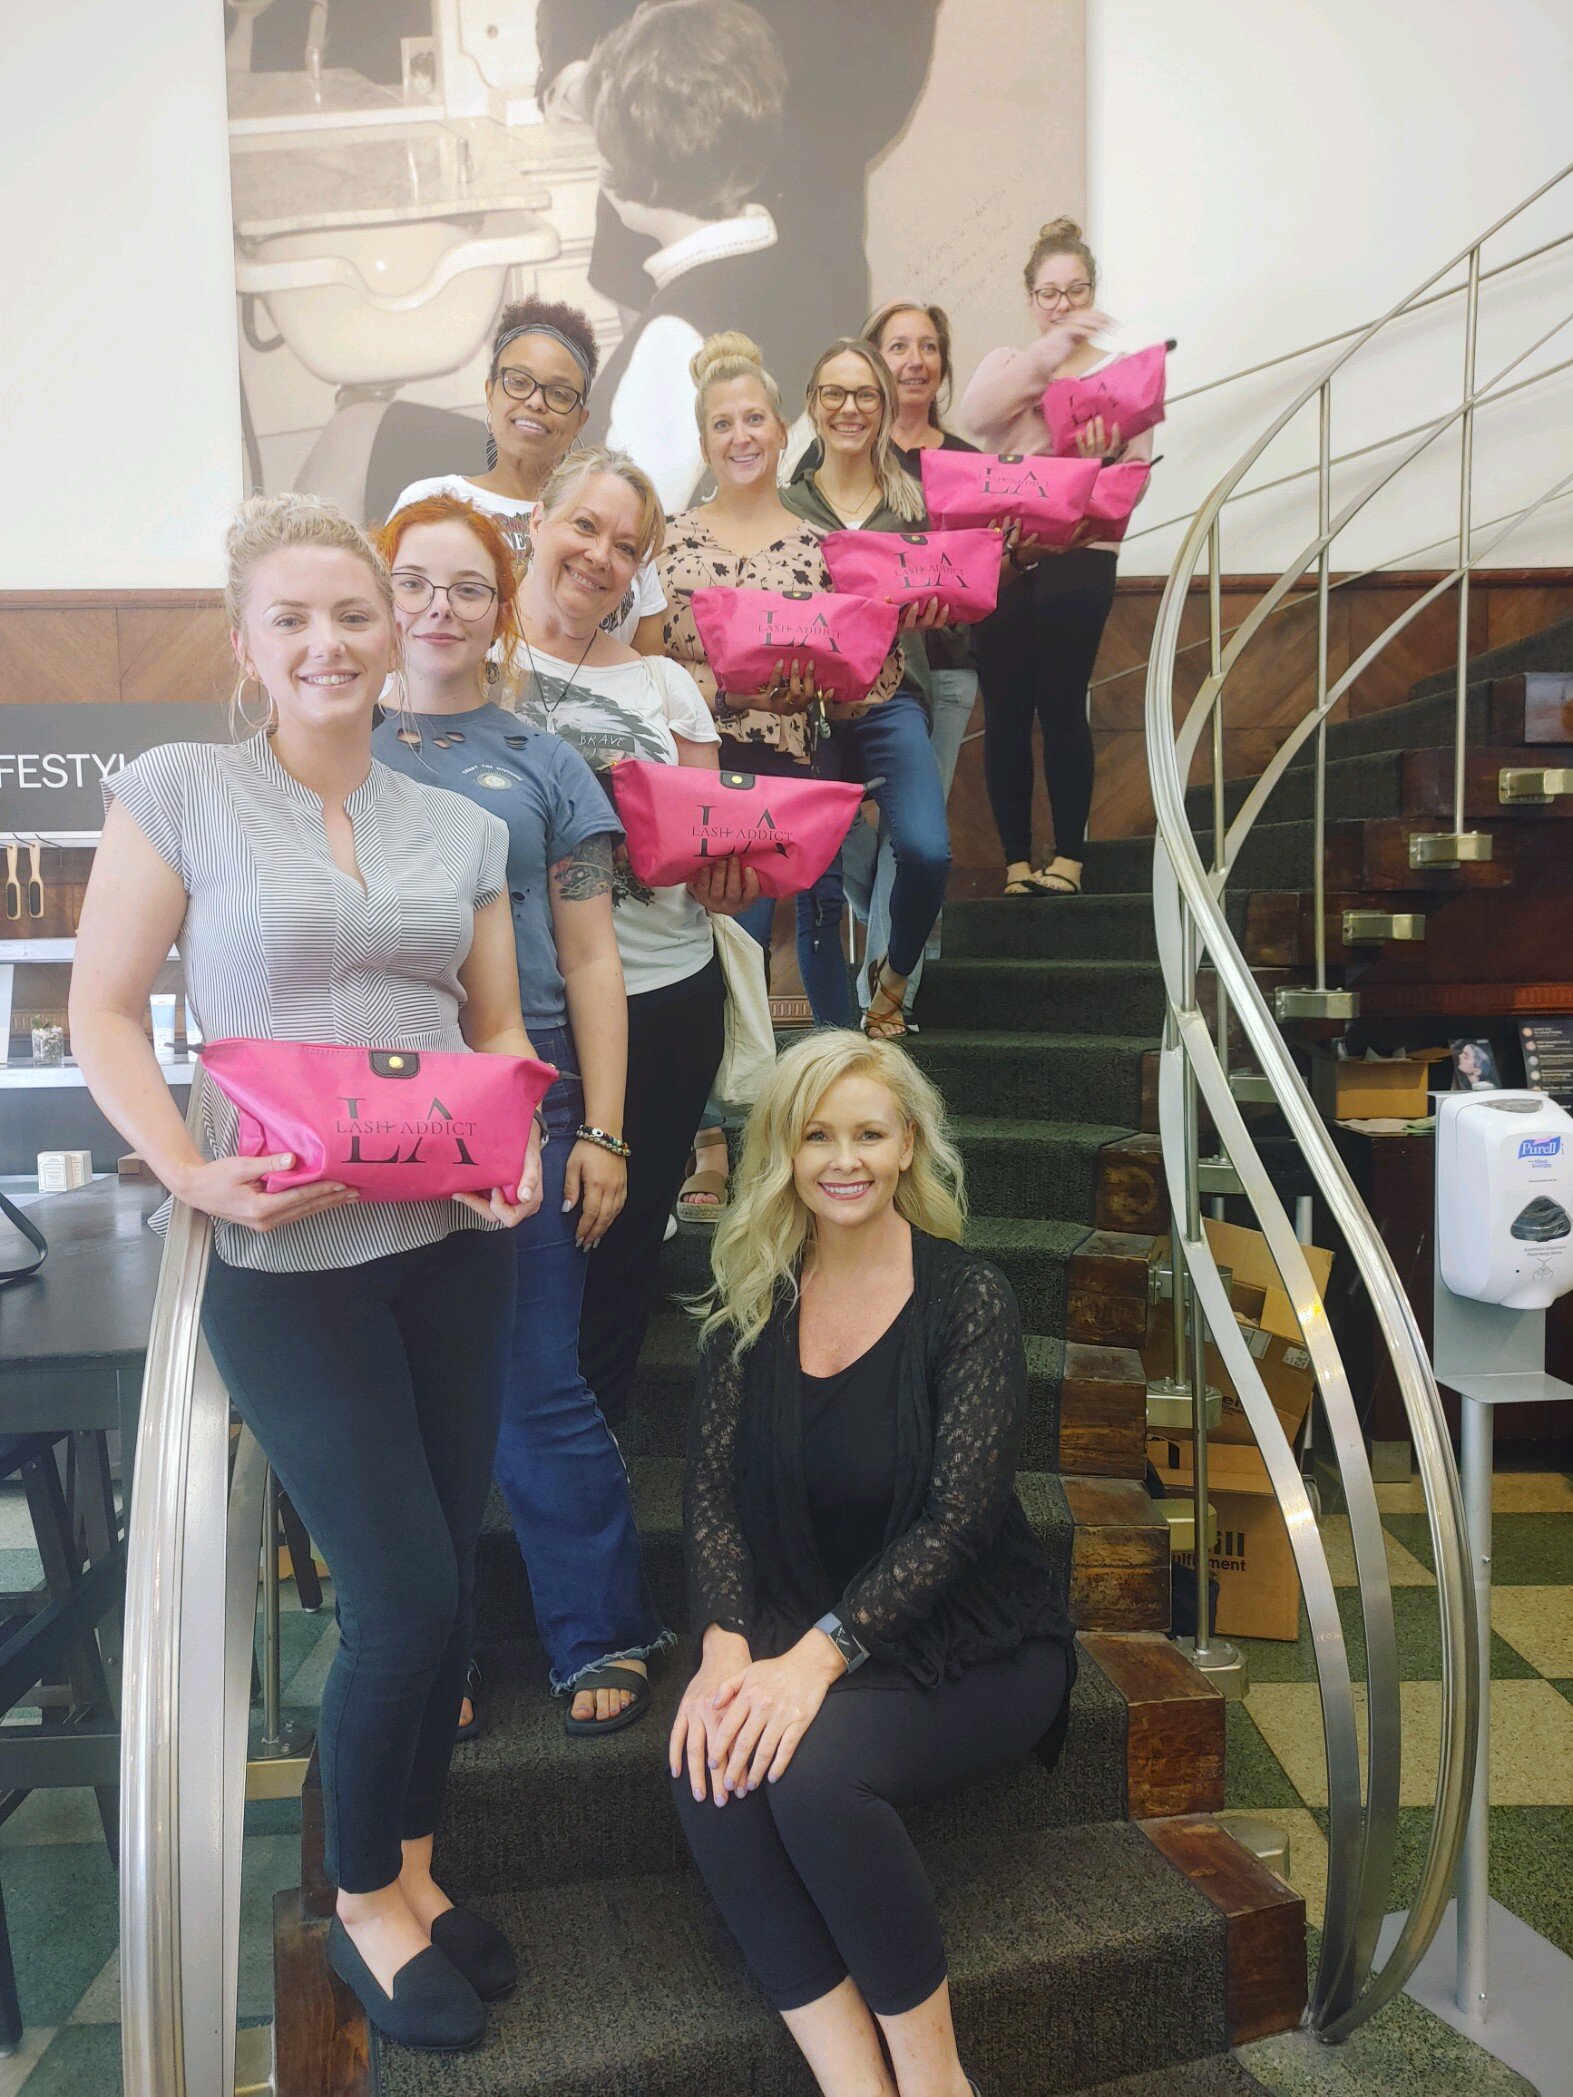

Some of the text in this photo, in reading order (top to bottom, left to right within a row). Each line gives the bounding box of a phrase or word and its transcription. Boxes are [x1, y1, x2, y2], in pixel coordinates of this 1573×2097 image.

[579, 734, 626, 747] BRAVE
[692, 826, 793, 842] LASH ADDICT
[336, 1120, 476, 1136] LASH ADDICT
